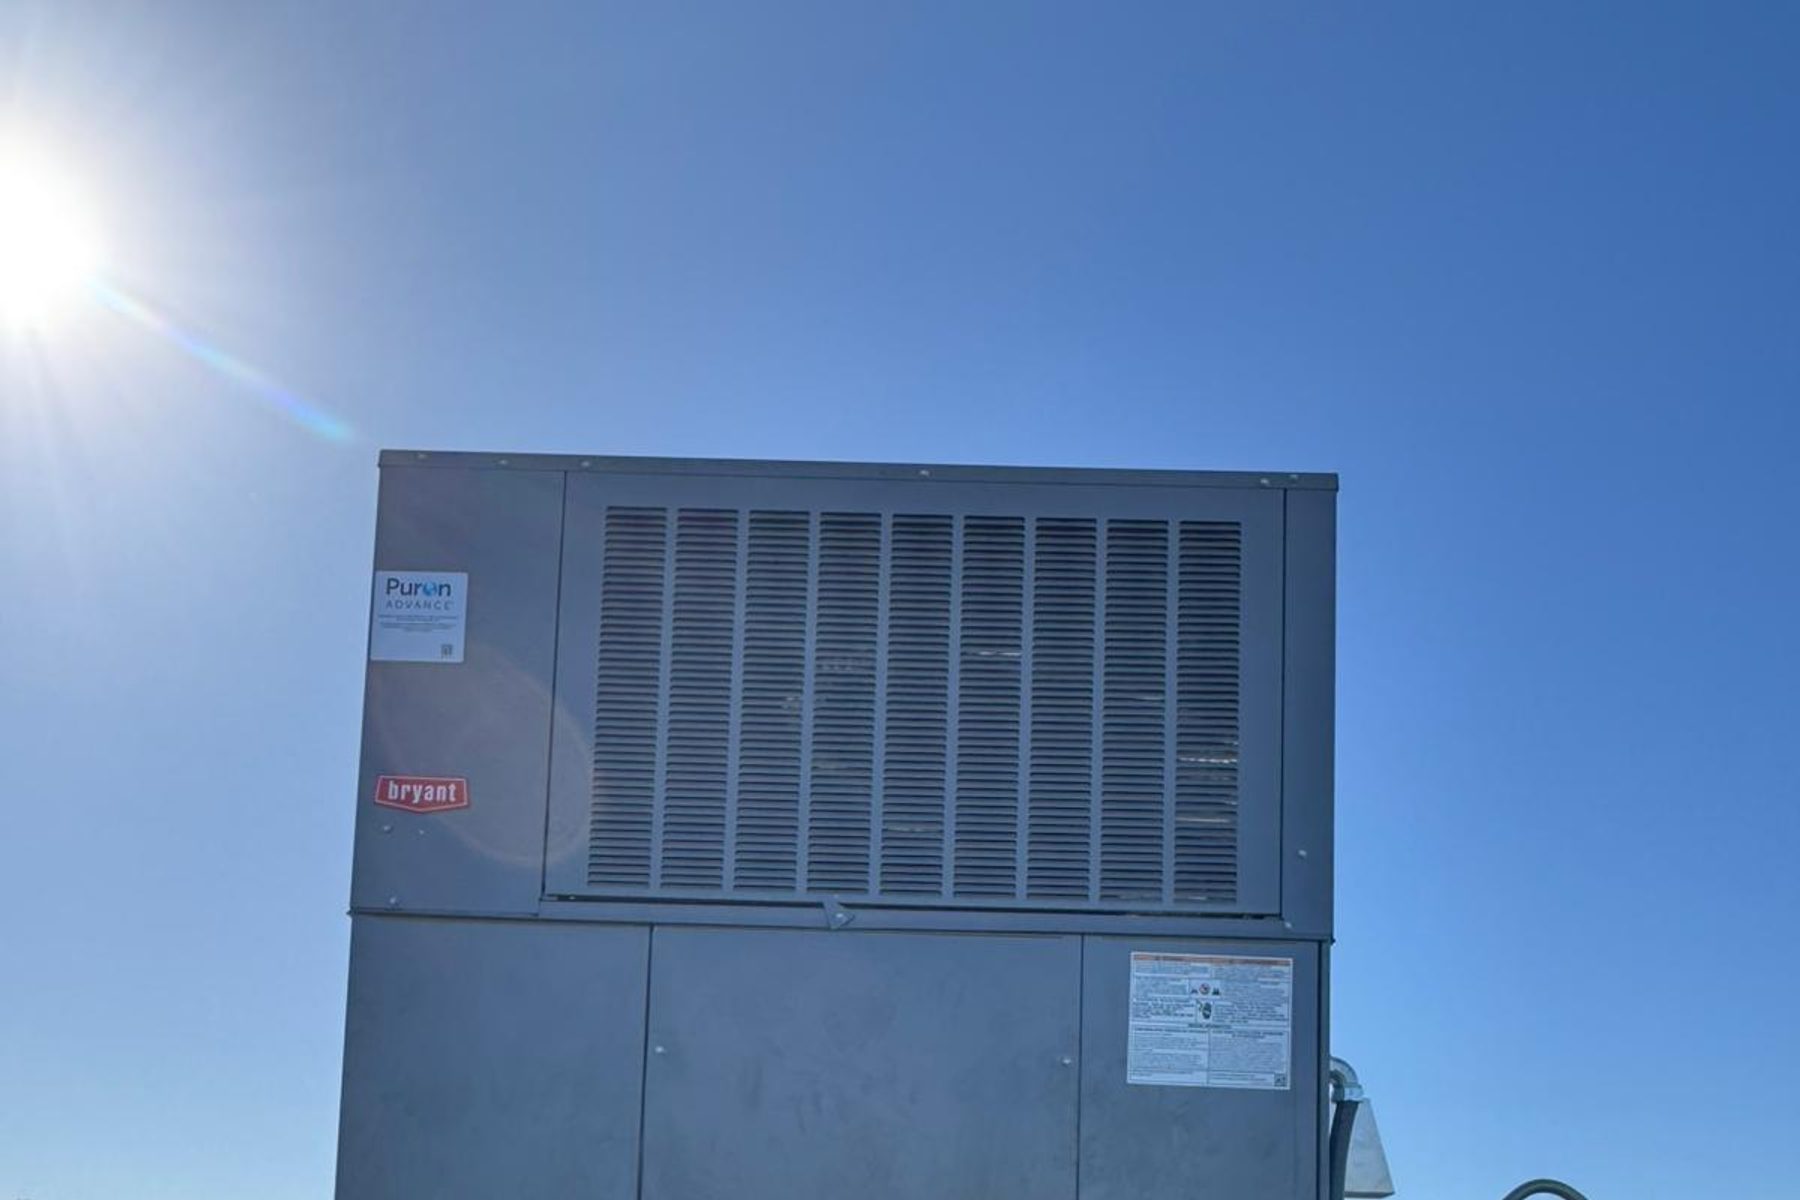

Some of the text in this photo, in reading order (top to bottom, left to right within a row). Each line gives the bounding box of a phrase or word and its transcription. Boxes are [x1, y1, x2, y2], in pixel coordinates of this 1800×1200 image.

[385, 577, 452, 597] Puron
[385, 599, 454, 611] ADVANCE
[387, 780, 457, 804] bryant
